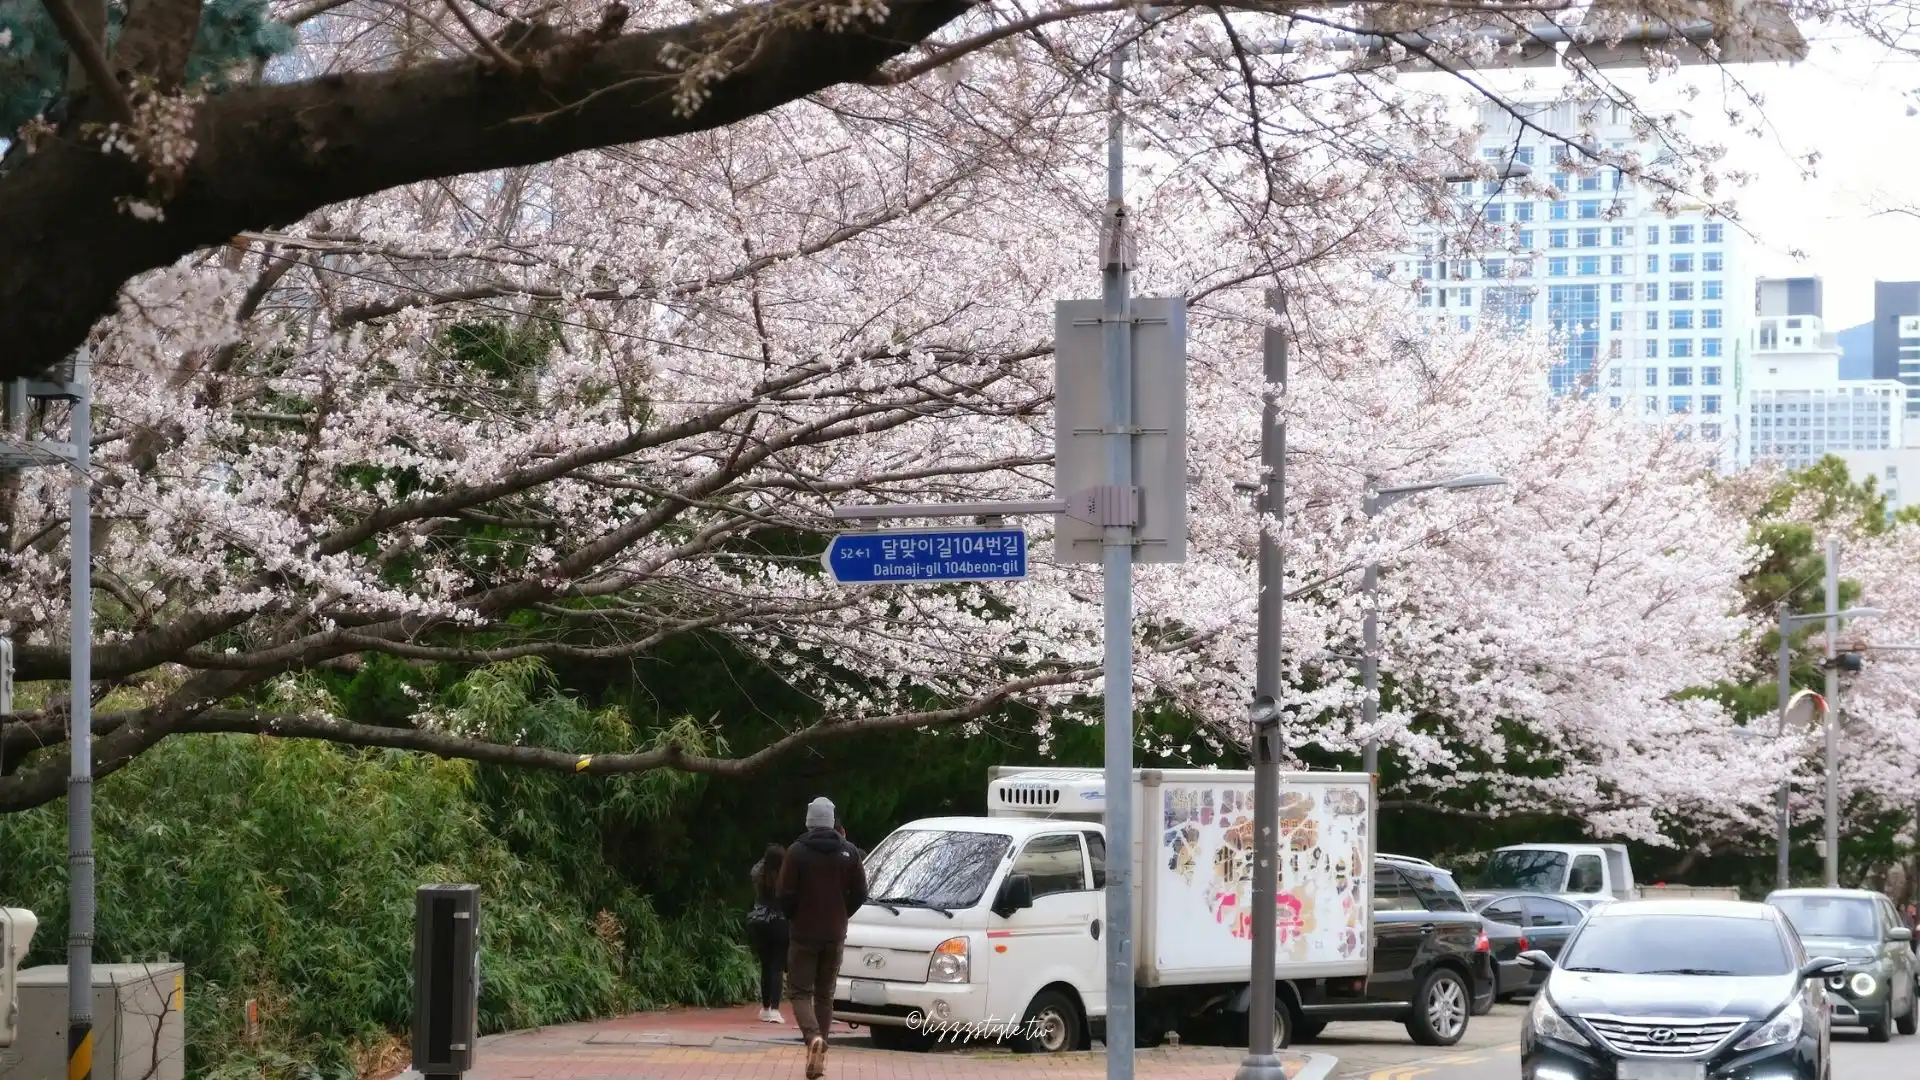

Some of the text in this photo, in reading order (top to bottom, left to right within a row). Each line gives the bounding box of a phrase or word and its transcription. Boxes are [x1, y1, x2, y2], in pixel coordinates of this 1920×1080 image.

[881, 536, 1018, 560] 달맞이길104번길
[873, 560, 1018, 577] Dalmaji-gil 104beon-gil
